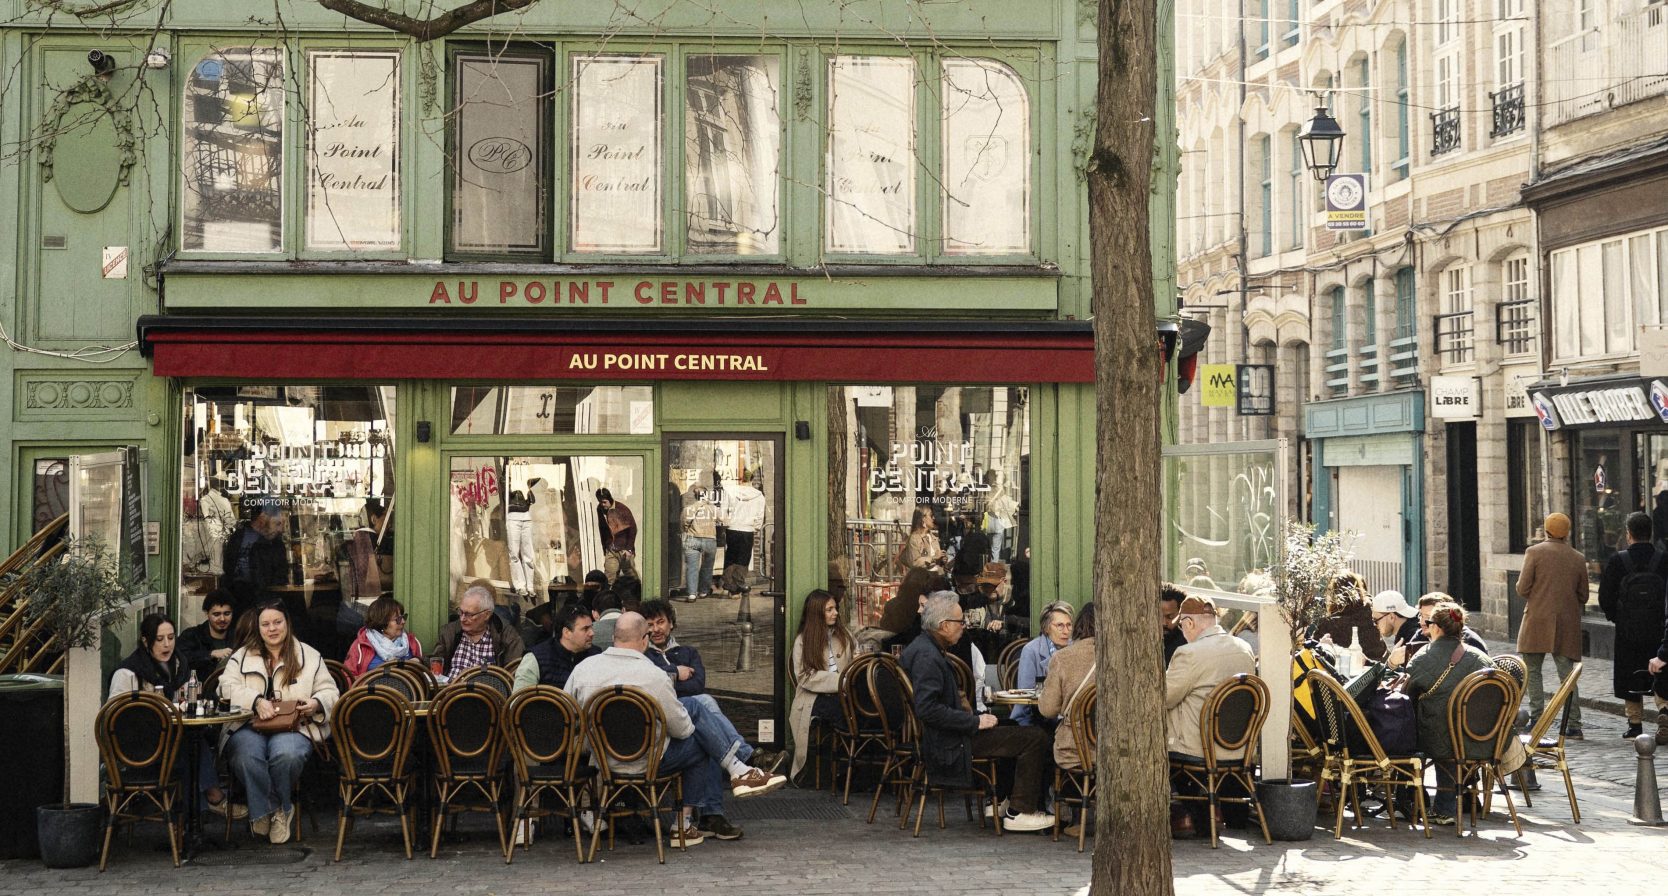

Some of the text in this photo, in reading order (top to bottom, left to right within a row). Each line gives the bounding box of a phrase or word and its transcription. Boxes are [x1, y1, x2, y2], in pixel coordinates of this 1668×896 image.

[338, 115, 368, 128] Au
[324, 142, 383, 158] Point
[587, 144, 645, 160] Point
[320, 173, 387, 190] Central
[583, 175, 650, 192] Central
[430, 282, 807, 305] AU POINT CENTRAL
[569, 353, 768, 371] AU POINT CENTRAL
[1435, 387, 1469, 396] CHAMP
[1586, 387, 1655, 422] BARBER
[916, 426, 938, 438] Au
[889, 440, 970, 465] POINT
[869, 467, 992, 492] CENTRAL
[243, 498, 289, 507] COMPTOIR
[887, 496, 973, 504] COMPTOIR MODERNE
